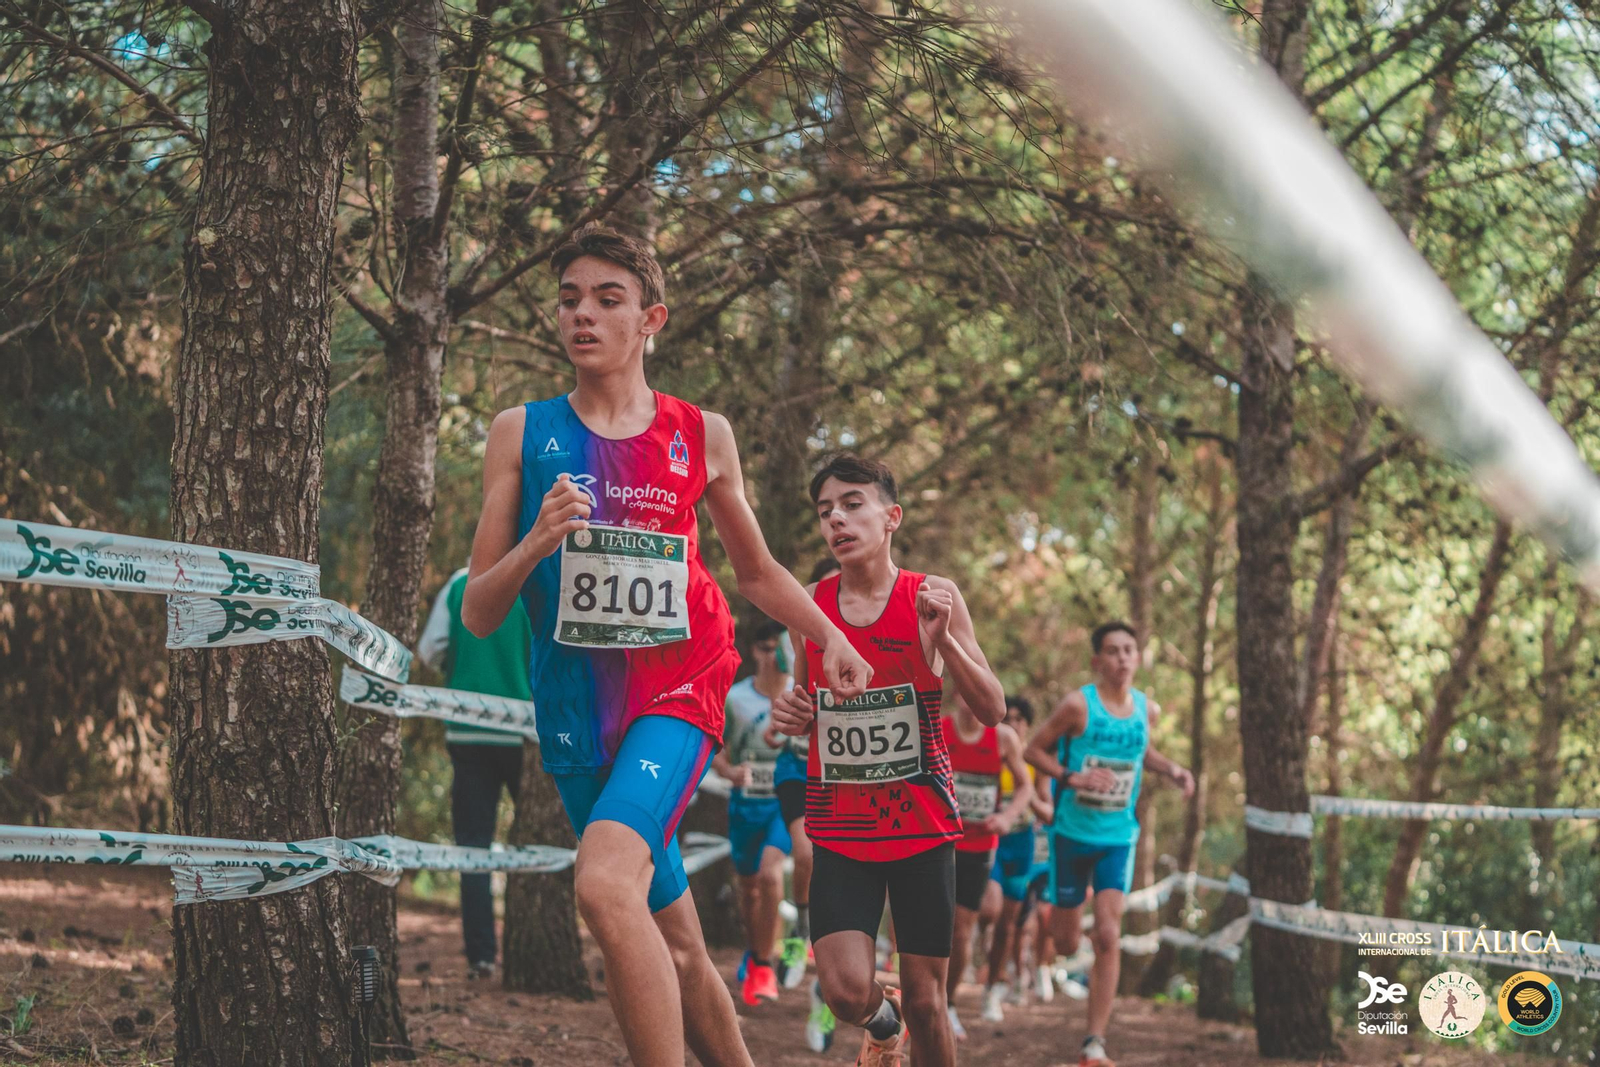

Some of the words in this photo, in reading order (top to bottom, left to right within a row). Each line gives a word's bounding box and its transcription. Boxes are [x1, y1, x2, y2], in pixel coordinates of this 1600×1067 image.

[606, 481, 677, 505] lapalma
[601, 532, 657, 551] ITÁLICA
[85, 560, 146, 583] Sevilla
[572, 572, 678, 618] 8101
[827, 721, 914, 757] 8052
